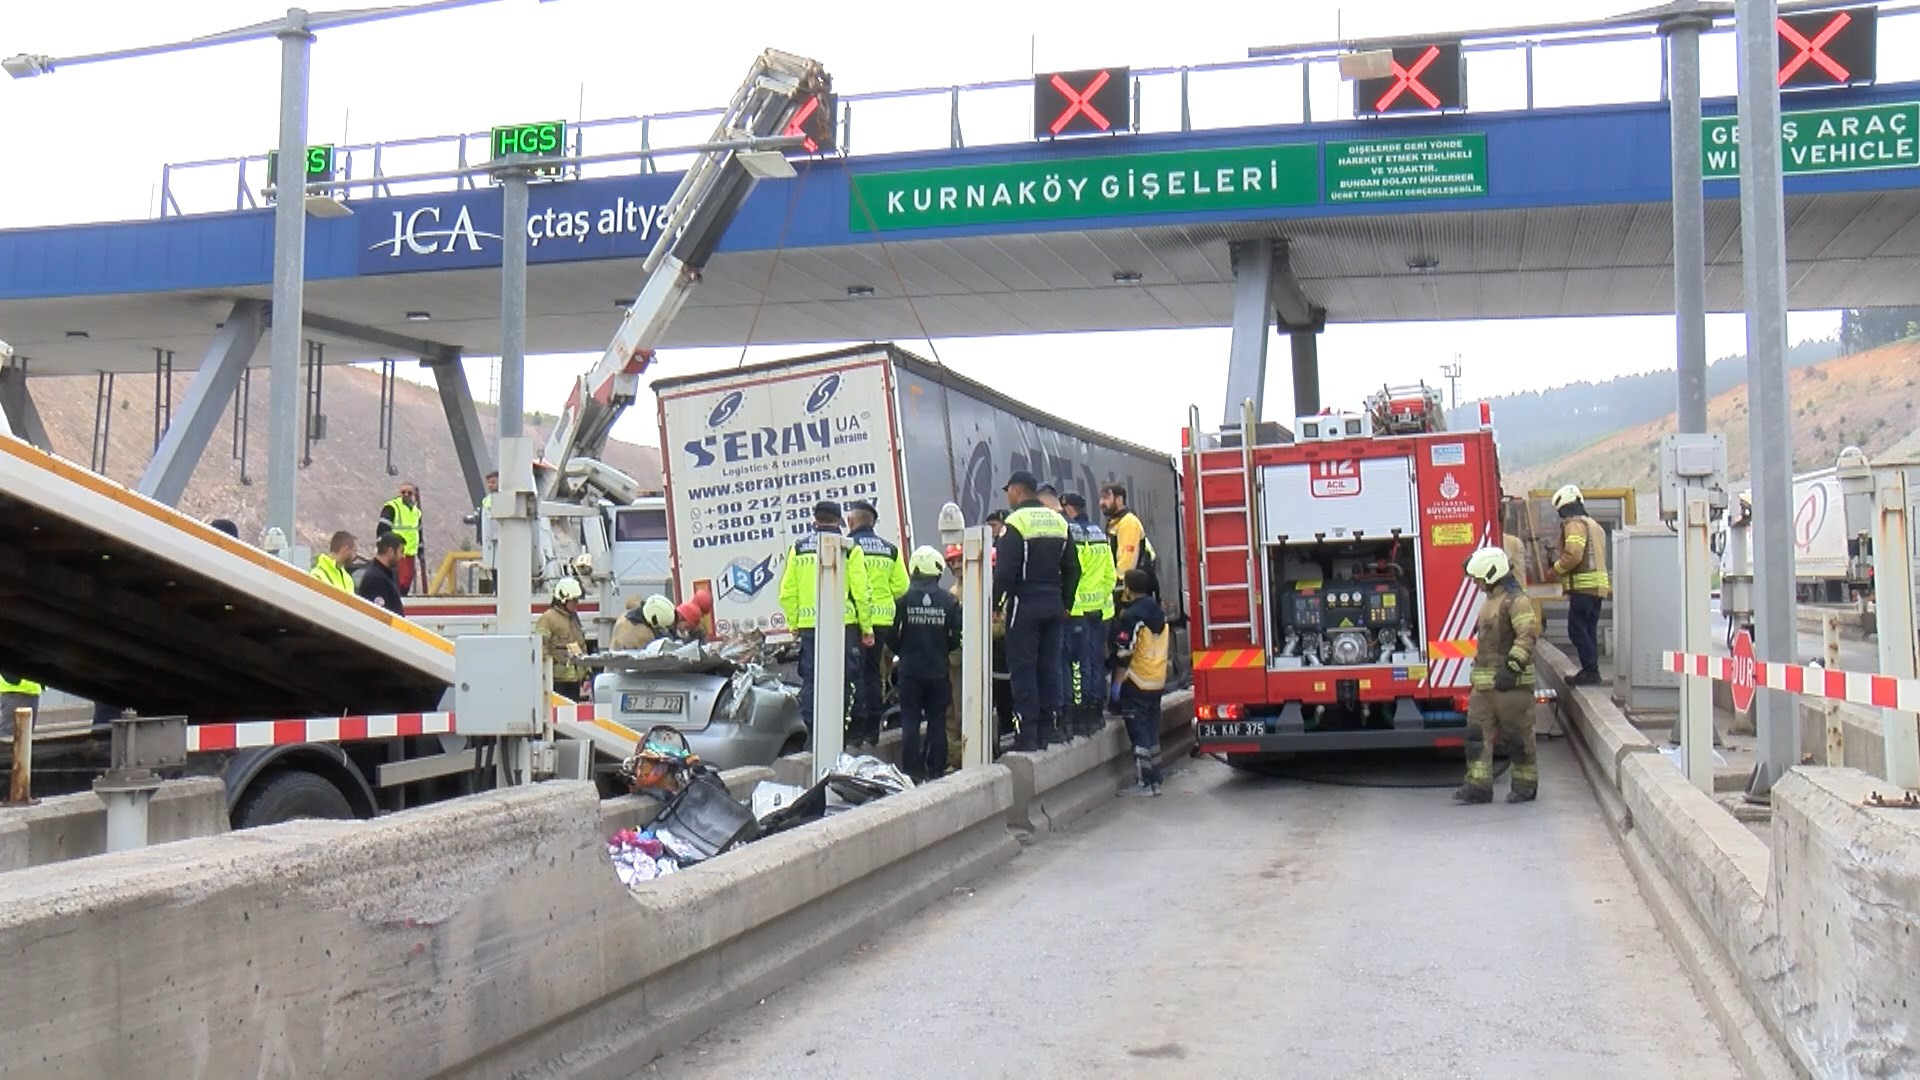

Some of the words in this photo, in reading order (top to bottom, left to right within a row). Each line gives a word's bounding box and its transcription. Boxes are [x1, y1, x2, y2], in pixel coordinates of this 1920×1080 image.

[1816, 113, 1907, 138] ARAÇ
[501, 126, 557, 155] HGS
[1349, 142, 1401, 154] GİŞELERDE
[1404, 140, 1428, 150] GERİ
[1430, 139, 1463, 149] YÖNDE
[1790, 138, 1914, 165] VEHICLE
[1338, 155, 1382, 166] HAREKET
[1385, 152, 1419, 163] ETMEK
[1422, 150, 1472, 161] TEHLİKELİ
[1340, 179, 1380, 188] BUNDAN
[1382, 177, 1417, 186] DOLAYI
[1420, 173, 1474, 184] MÜKERRER
[1371, 167, 1384, 175] VE
[888, 174, 1089, 214] KURNAKÖY
[1101, 160, 1278, 200] GİŞELERİ
[1331, 191, 1358, 200] ÜCRET
[684, 417, 831, 468] SERAY
[834, 431, 868, 445] ukraine
[722, 461, 769, 477] Logistics
[782, 453, 831, 471] transport
[688, 462, 876, 500] www.seraytrans.com
[704, 502, 743, 516] +90
[748, 496, 781, 511] 212
[786, 490, 821, 504] 451
[826, 485, 848, 499] 51
[854, 481, 877, 494] 01
[705, 515, 755, 530] +380
[760, 511, 781, 524] 97
[693, 527, 775, 548] OVRUCH
[1732, 655, 1754, 688] DUR
[1204, 725, 1217, 736] 34
[1245, 723, 1264, 736] 375
